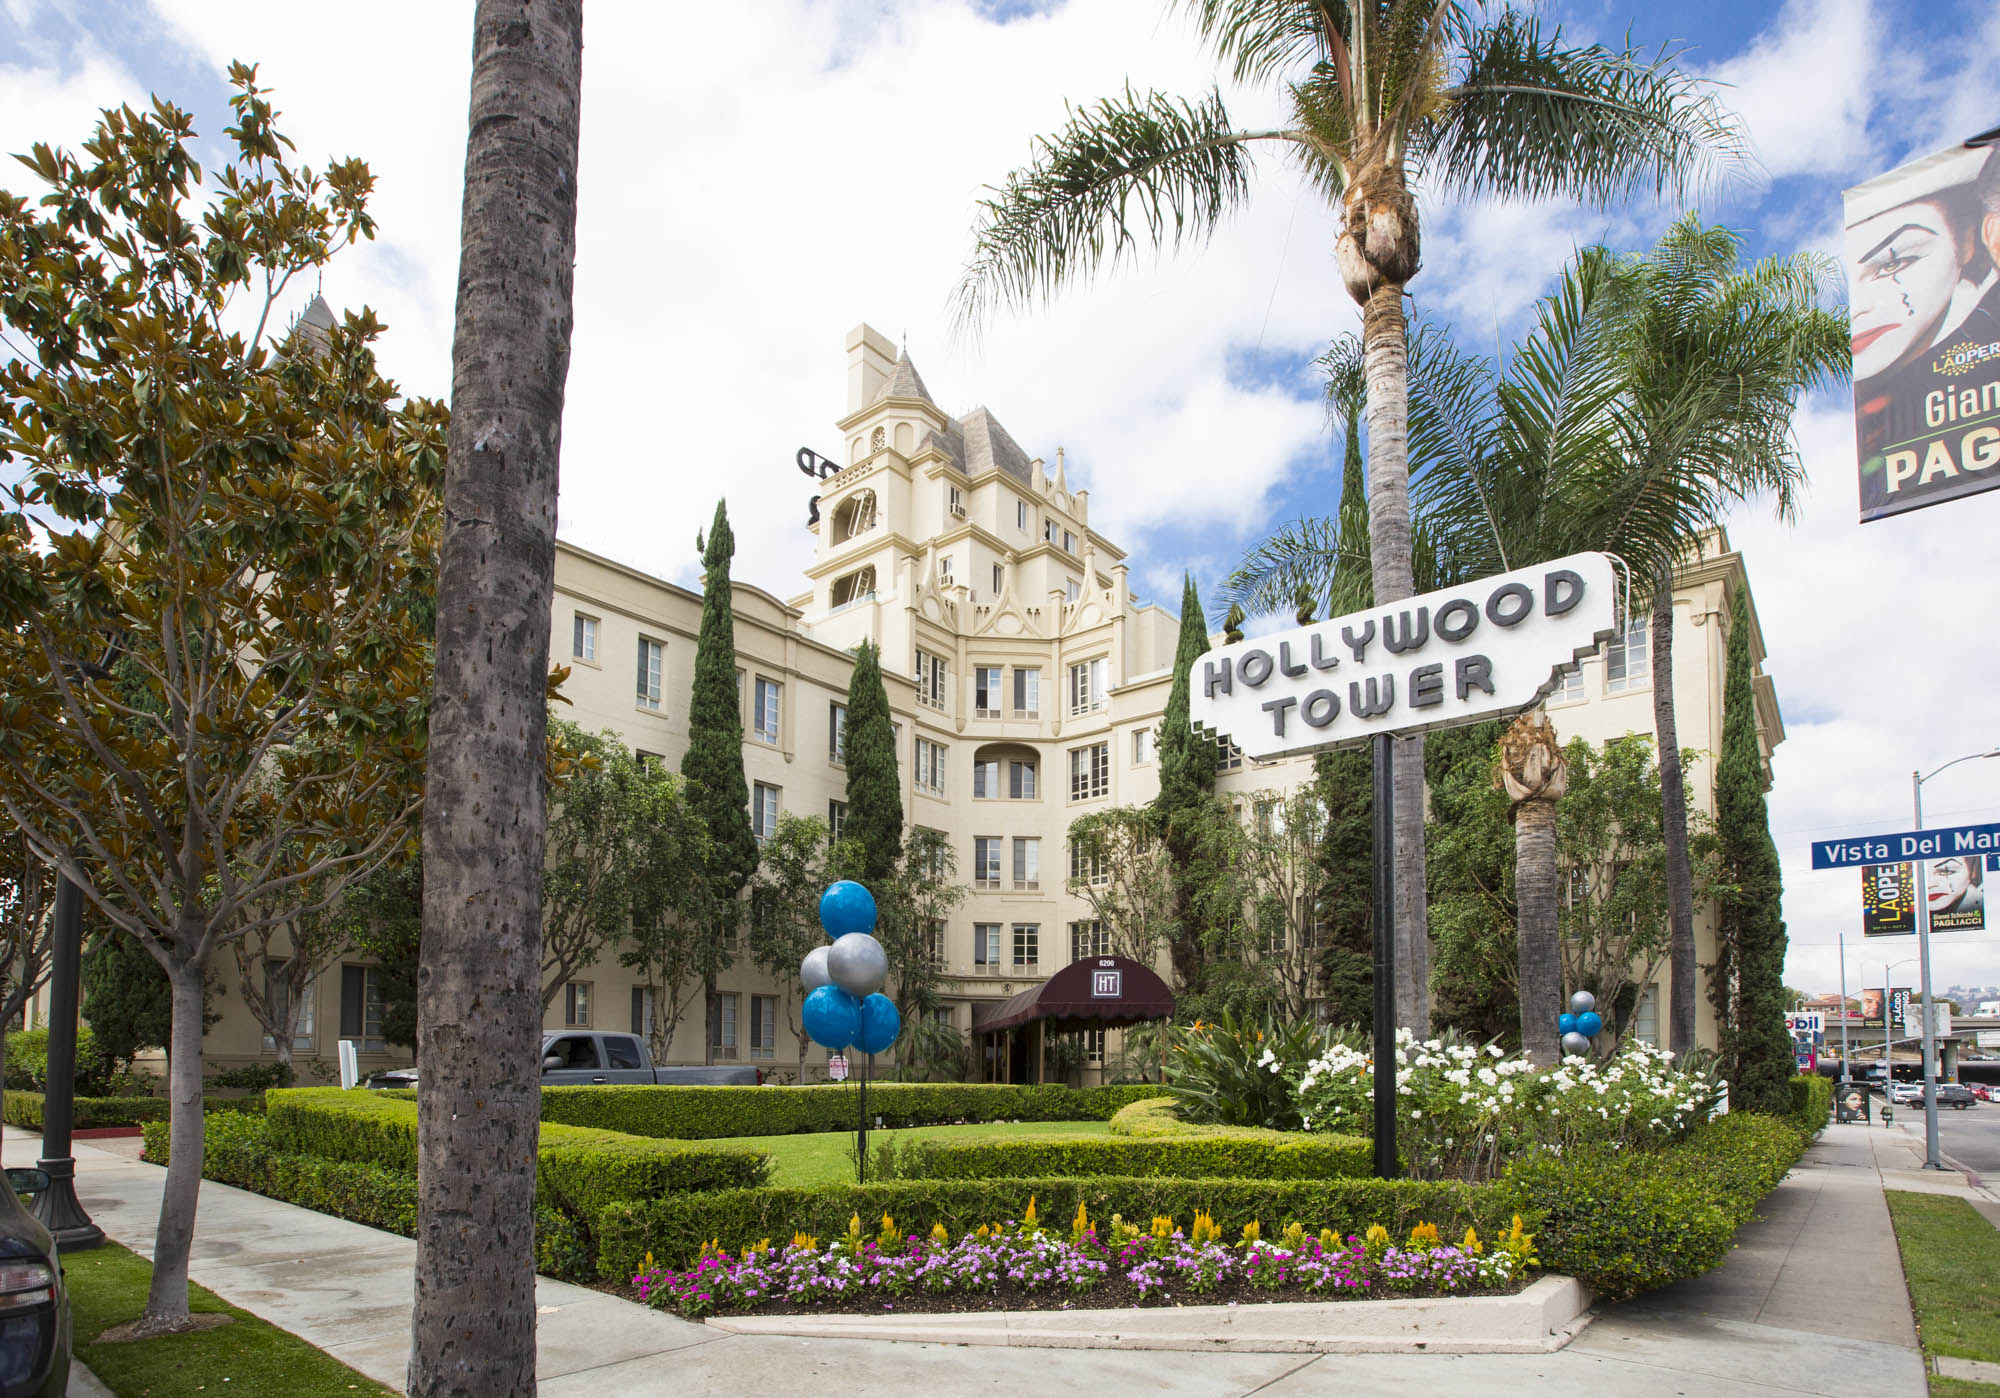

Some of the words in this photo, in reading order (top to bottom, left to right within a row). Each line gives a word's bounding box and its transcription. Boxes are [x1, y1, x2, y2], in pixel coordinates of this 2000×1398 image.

[1925, 381, 2000, 428] Gian
[1885, 426, 2000, 494] PAG
[1204, 569, 1585, 700] HOLLYWOOD
[1261, 654, 1495, 738] TOWER
[1825, 841, 1889, 863] Vista
[1901, 834, 1941, 856] Del
[1933, 917, 1982, 927] PAGLIACCI
[1099, 975, 1116, 992] HT
[1784, 1016, 1818, 1029] obil
